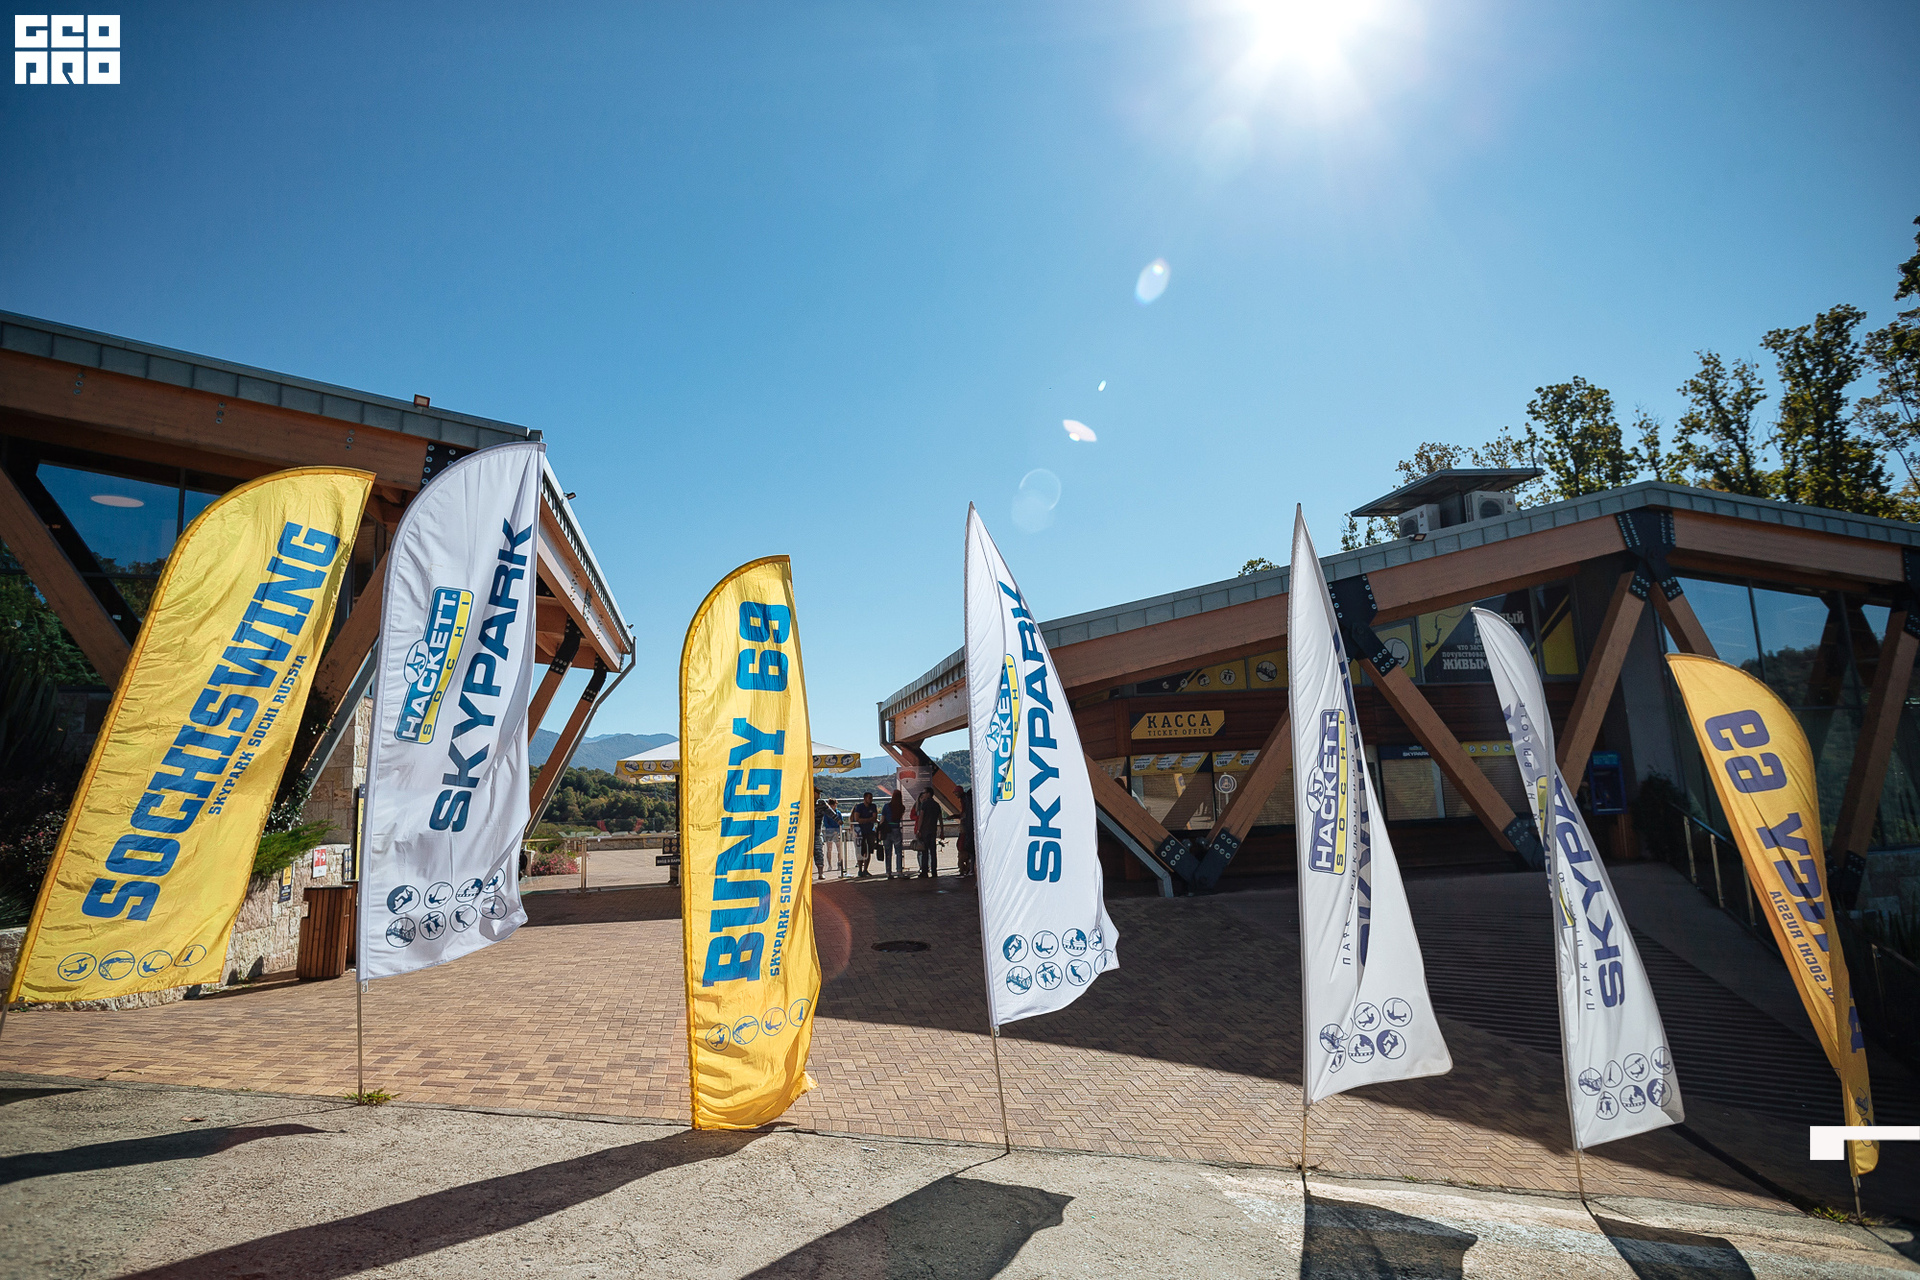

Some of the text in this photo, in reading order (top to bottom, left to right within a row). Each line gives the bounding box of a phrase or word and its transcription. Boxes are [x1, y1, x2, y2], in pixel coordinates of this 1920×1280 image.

[82, 521, 341, 921] SOCHISWING
[208, 655, 308, 815] SKYPARK SOCHI RUSSIA
[401, 592, 456, 738] HACKETT
[429, 517, 533, 832] SKYPARK
[998, 580, 1062, 882] SKYPARK
[1146, 713, 1212, 729] КАССА
[1148, 728, 1212, 737] TICKET OFFICE
[702, 601, 791, 987] BUNGY 69
[1316, 715, 1337, 868] HACKETT
[770, 800, 801, 977] SKYPARK SOCHI RUSSIA
[1579, 961, 1596, 1010] ПАРК
